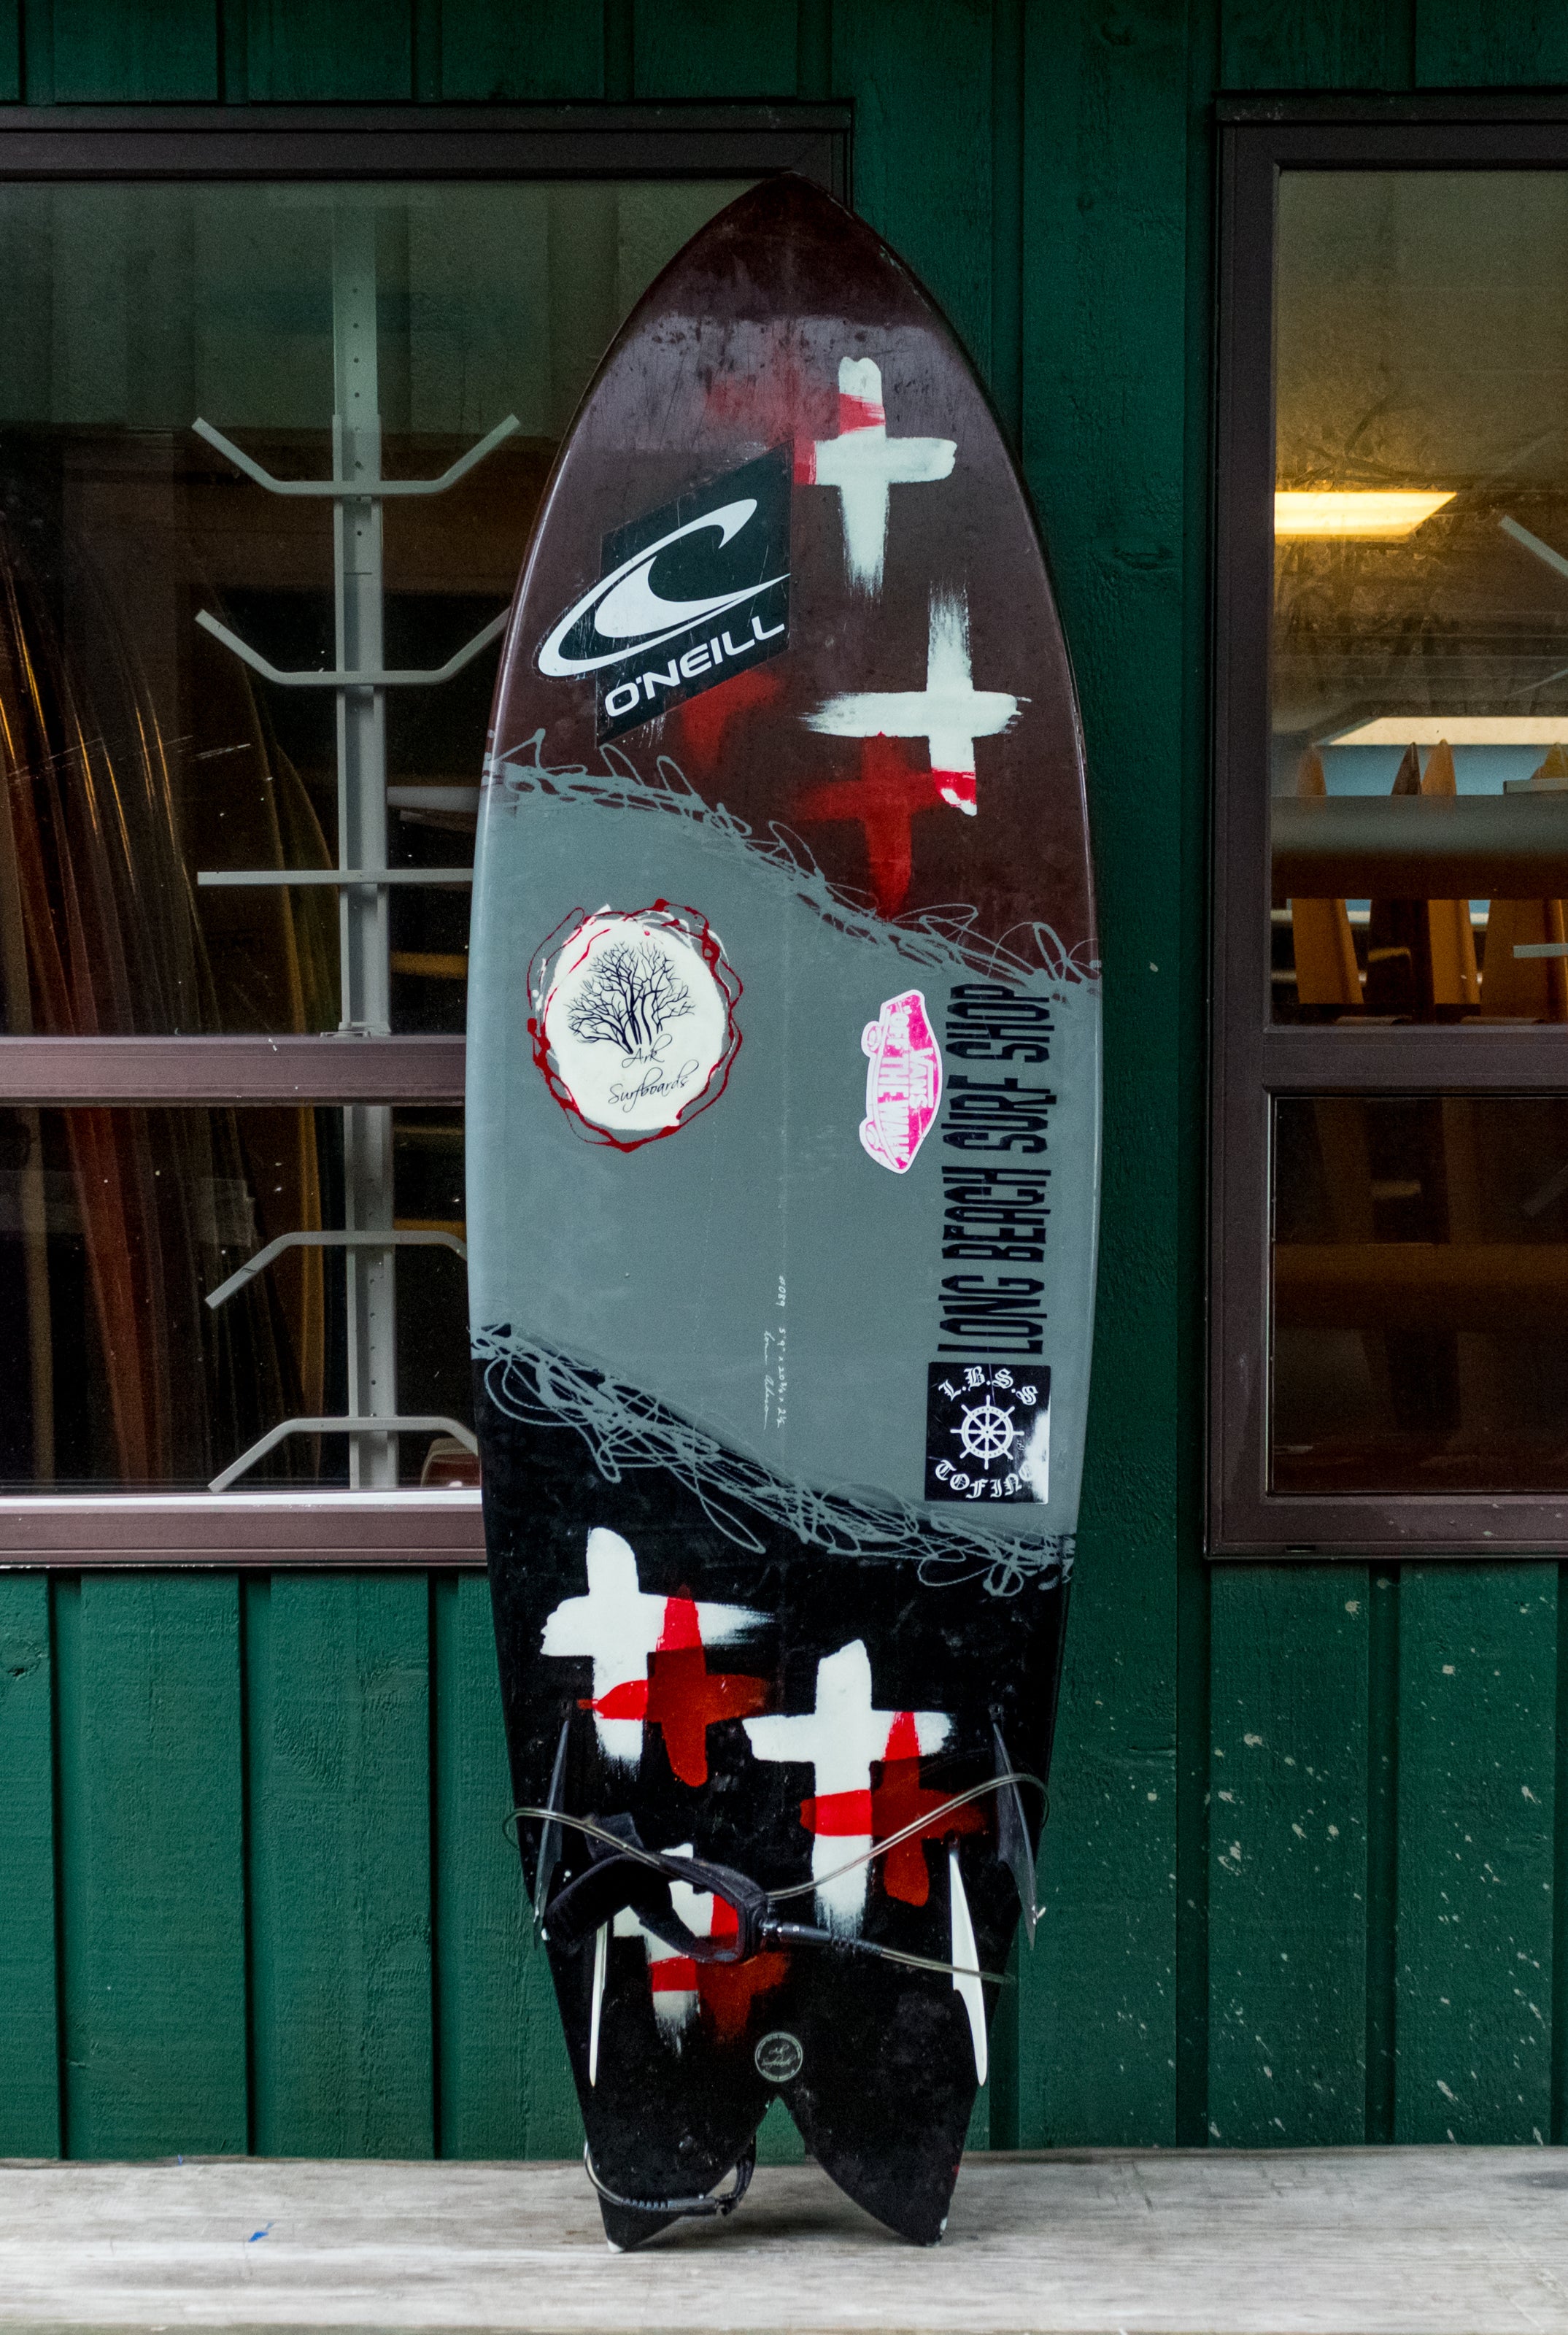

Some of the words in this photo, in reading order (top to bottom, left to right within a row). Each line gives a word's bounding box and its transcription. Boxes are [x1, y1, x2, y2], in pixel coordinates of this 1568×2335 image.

[604, 615, 785, 717] O'NEILL
[621, 1033, 673, 1068] Ark
[946, 984, 1054, 1063] SHOP
[608, 1059, 700, 1113] Surfboards
[877, 1053, 909, 1100] THE
[908, 1047, 934, 1108] VANS
[941, 1075, 1057, 1154] SURF
[942, 1166, 1051, 1263] BEACH
[937, 1275, 1047, 1355] LONG
